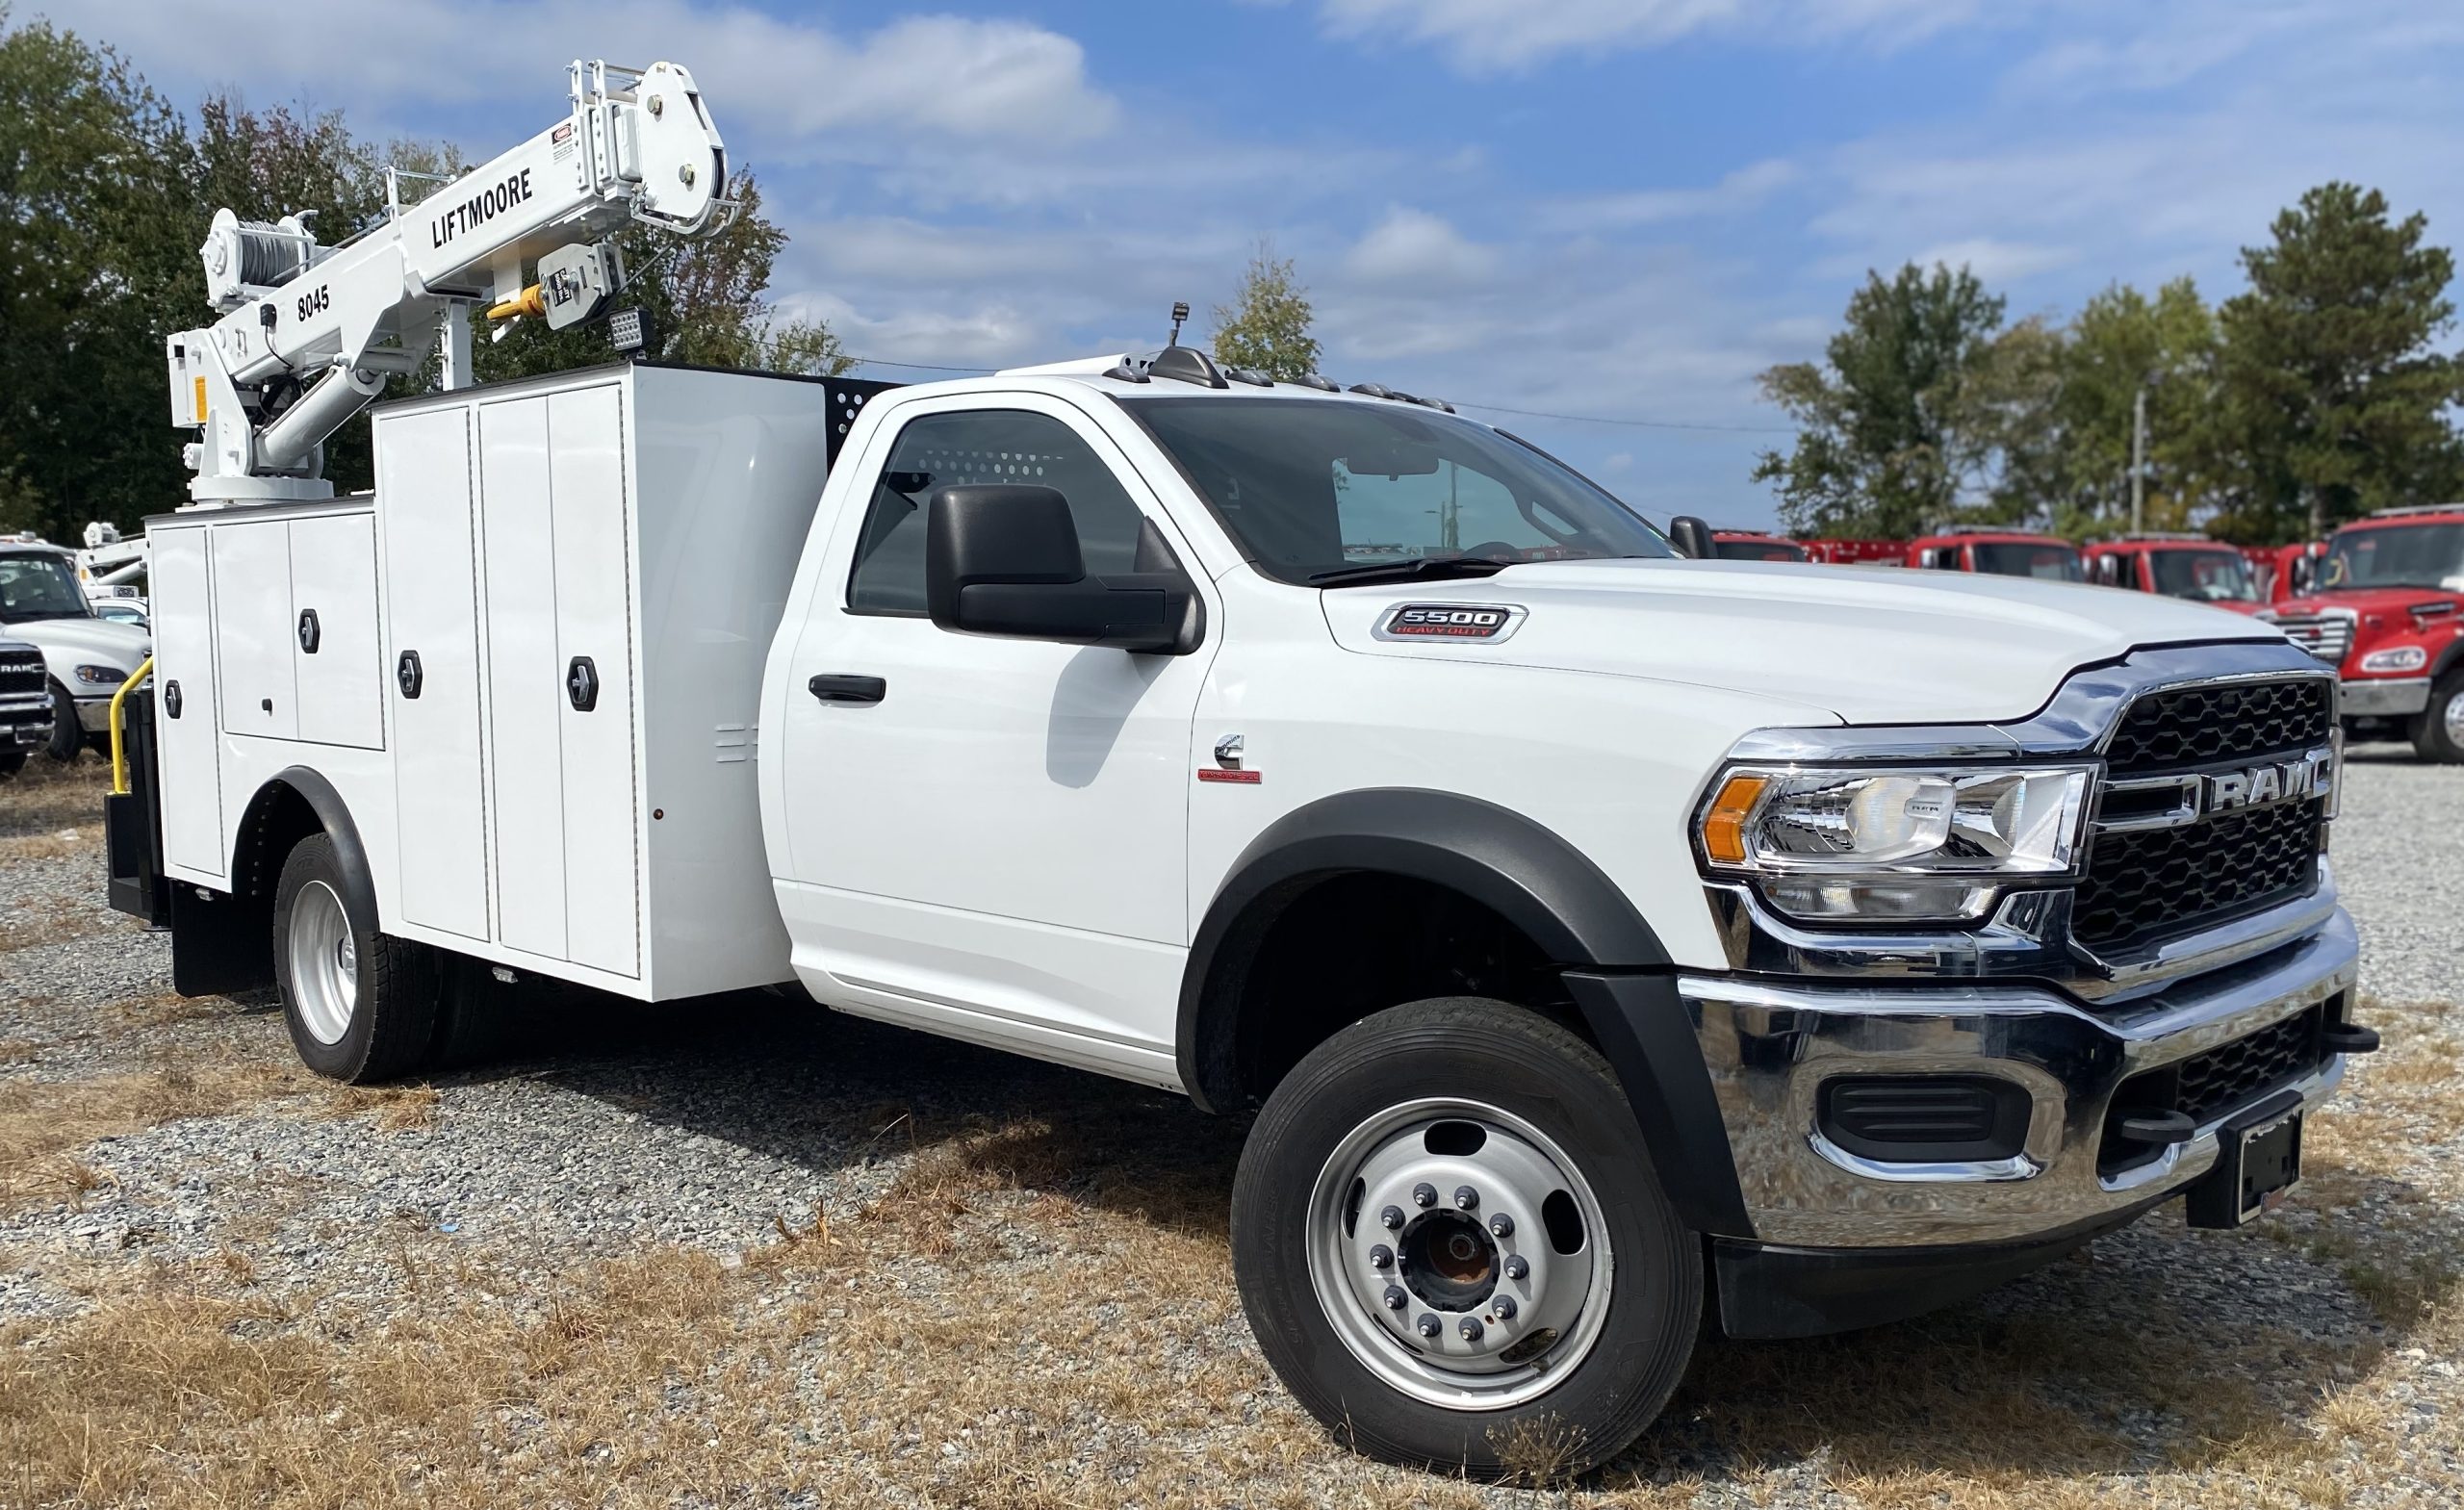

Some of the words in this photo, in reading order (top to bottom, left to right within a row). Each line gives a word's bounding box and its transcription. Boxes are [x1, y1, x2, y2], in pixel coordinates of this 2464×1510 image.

[431, 166, 533, 249] LIFTMOORE
[297, 284, 329, 322] 8045
[1396, 626, 1444, 635] HEAVY
[1447, 627, 1491, 636] DUTY
[1403, 610, 1499, 627] 5500
[0, 664, 32, 673] RAM
[2209, 759, 2313, 812] RAM
